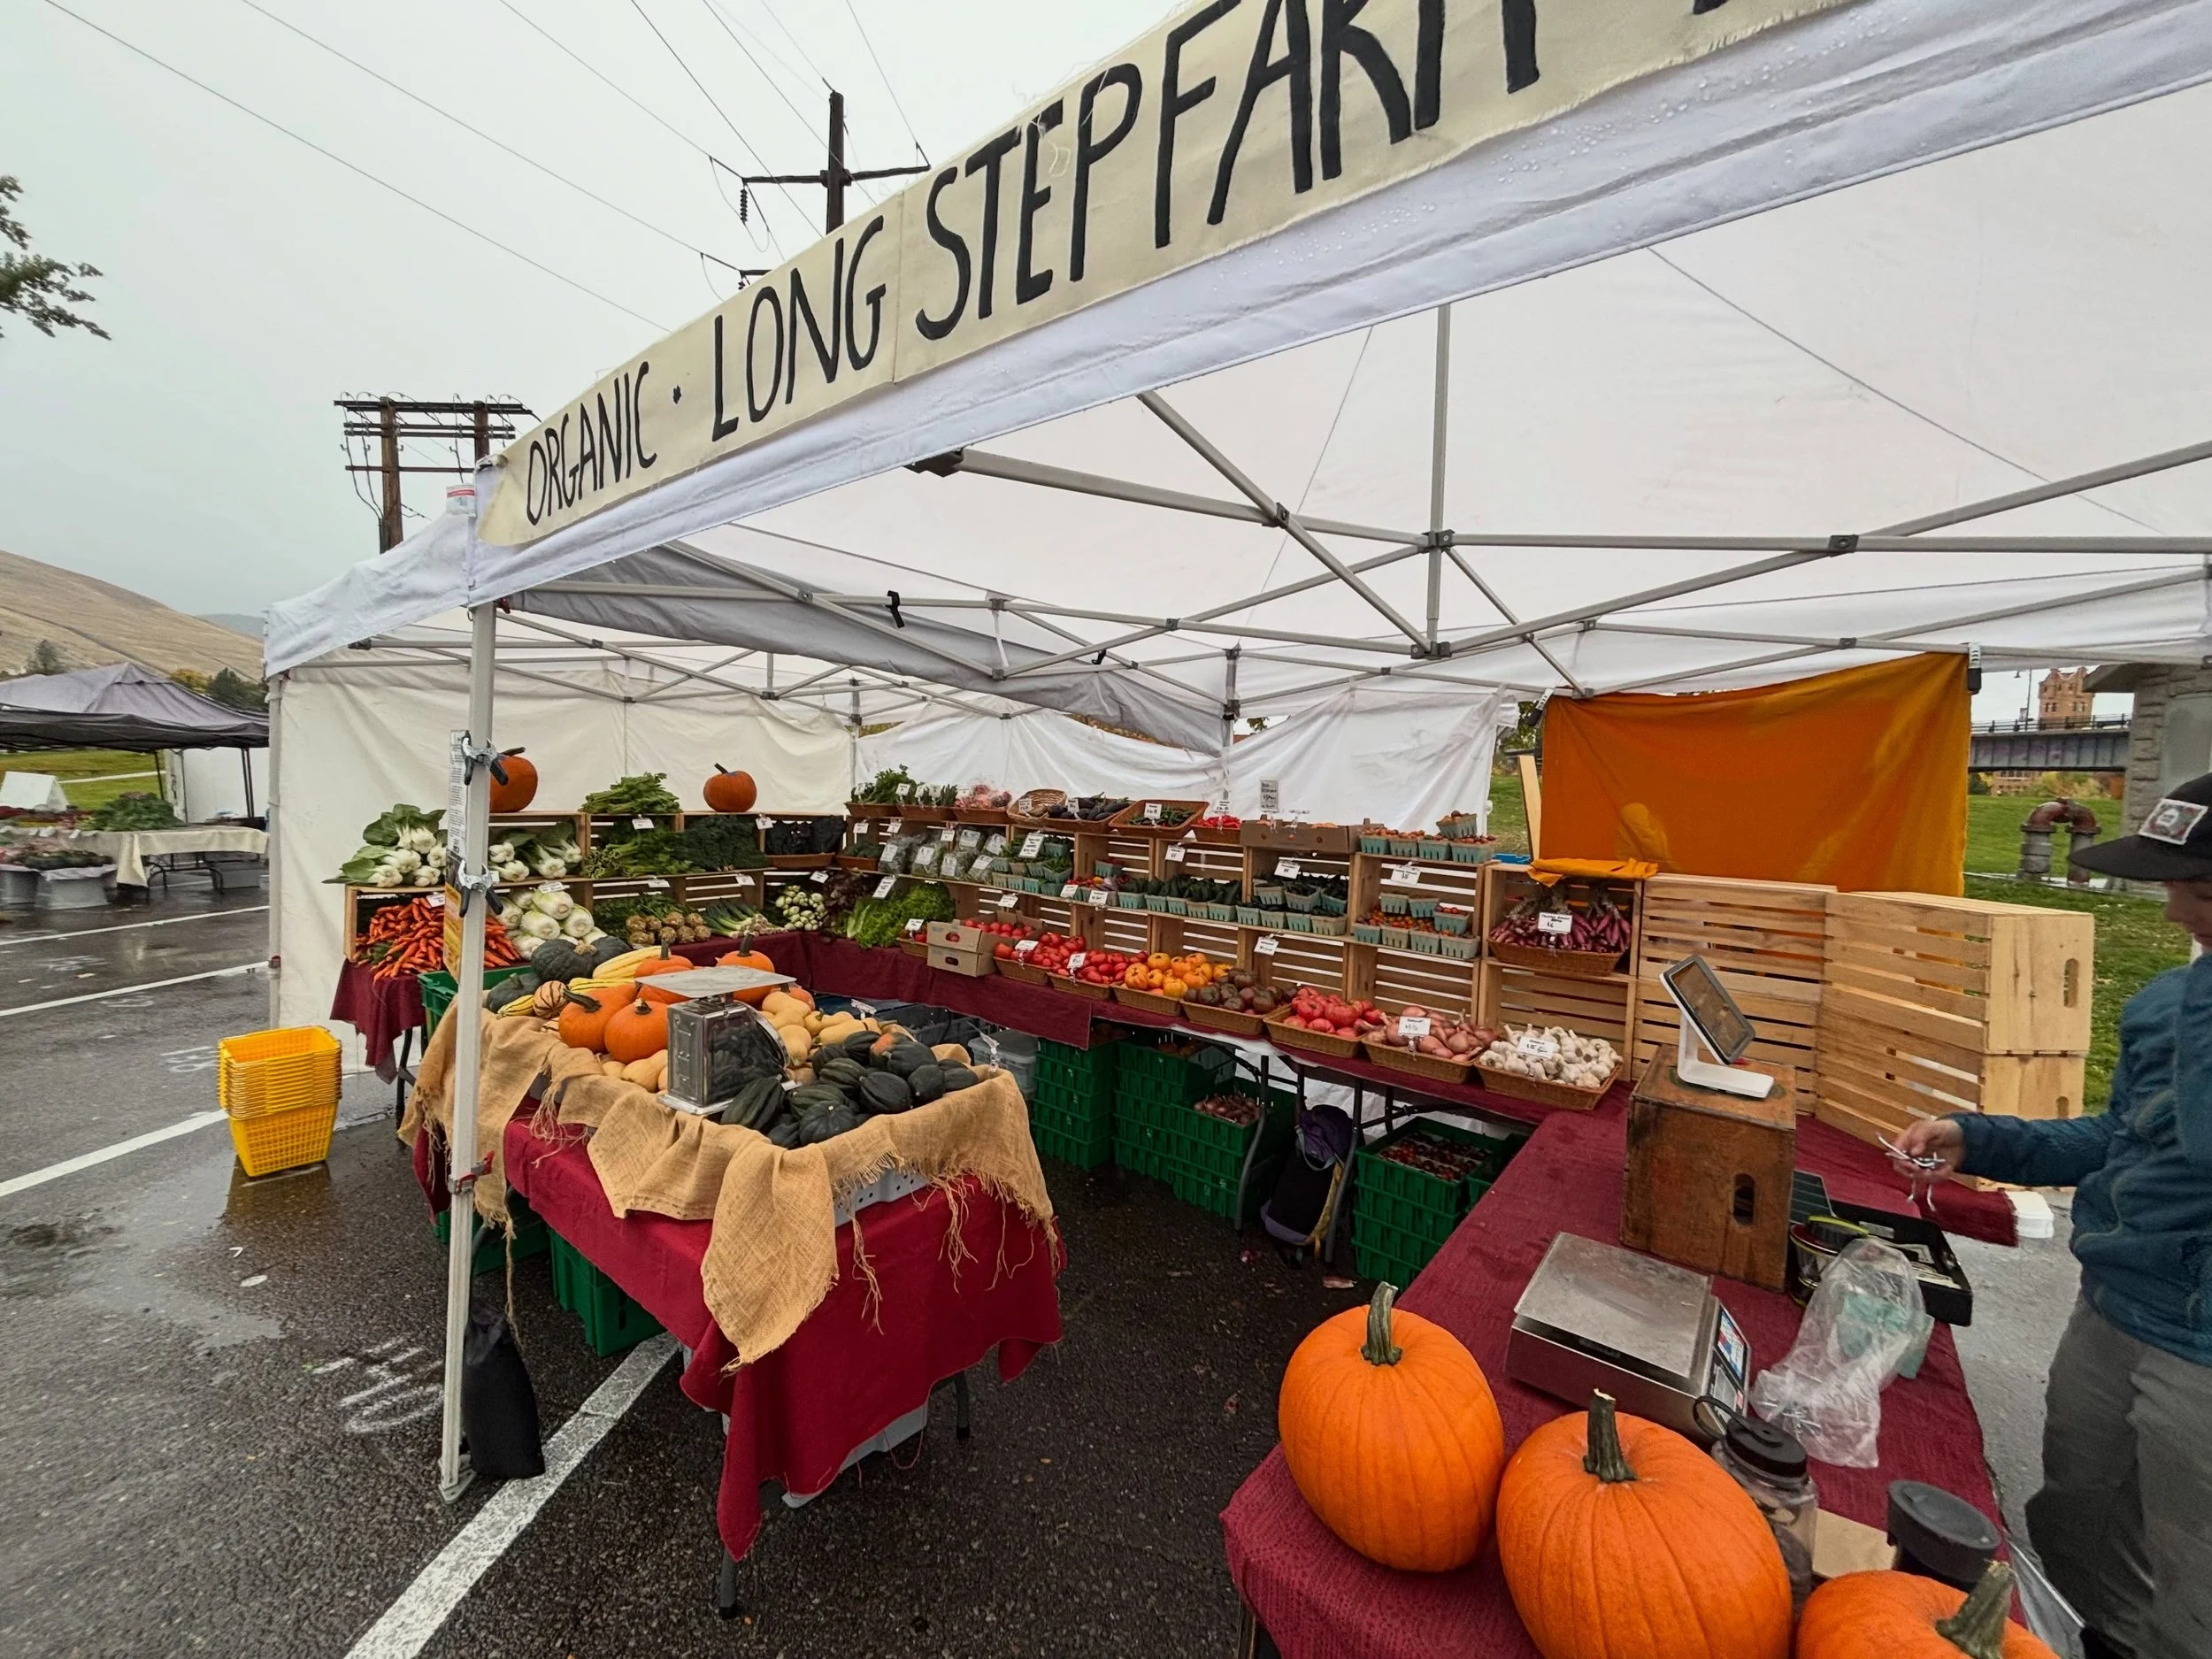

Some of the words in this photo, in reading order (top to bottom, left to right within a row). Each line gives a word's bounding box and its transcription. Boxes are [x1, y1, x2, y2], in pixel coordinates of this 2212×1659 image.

[526, 361, 657, 526] ORGANIC
[711, 215, 887, 442] LONG
[917, 64, 1142, 339] STEP
